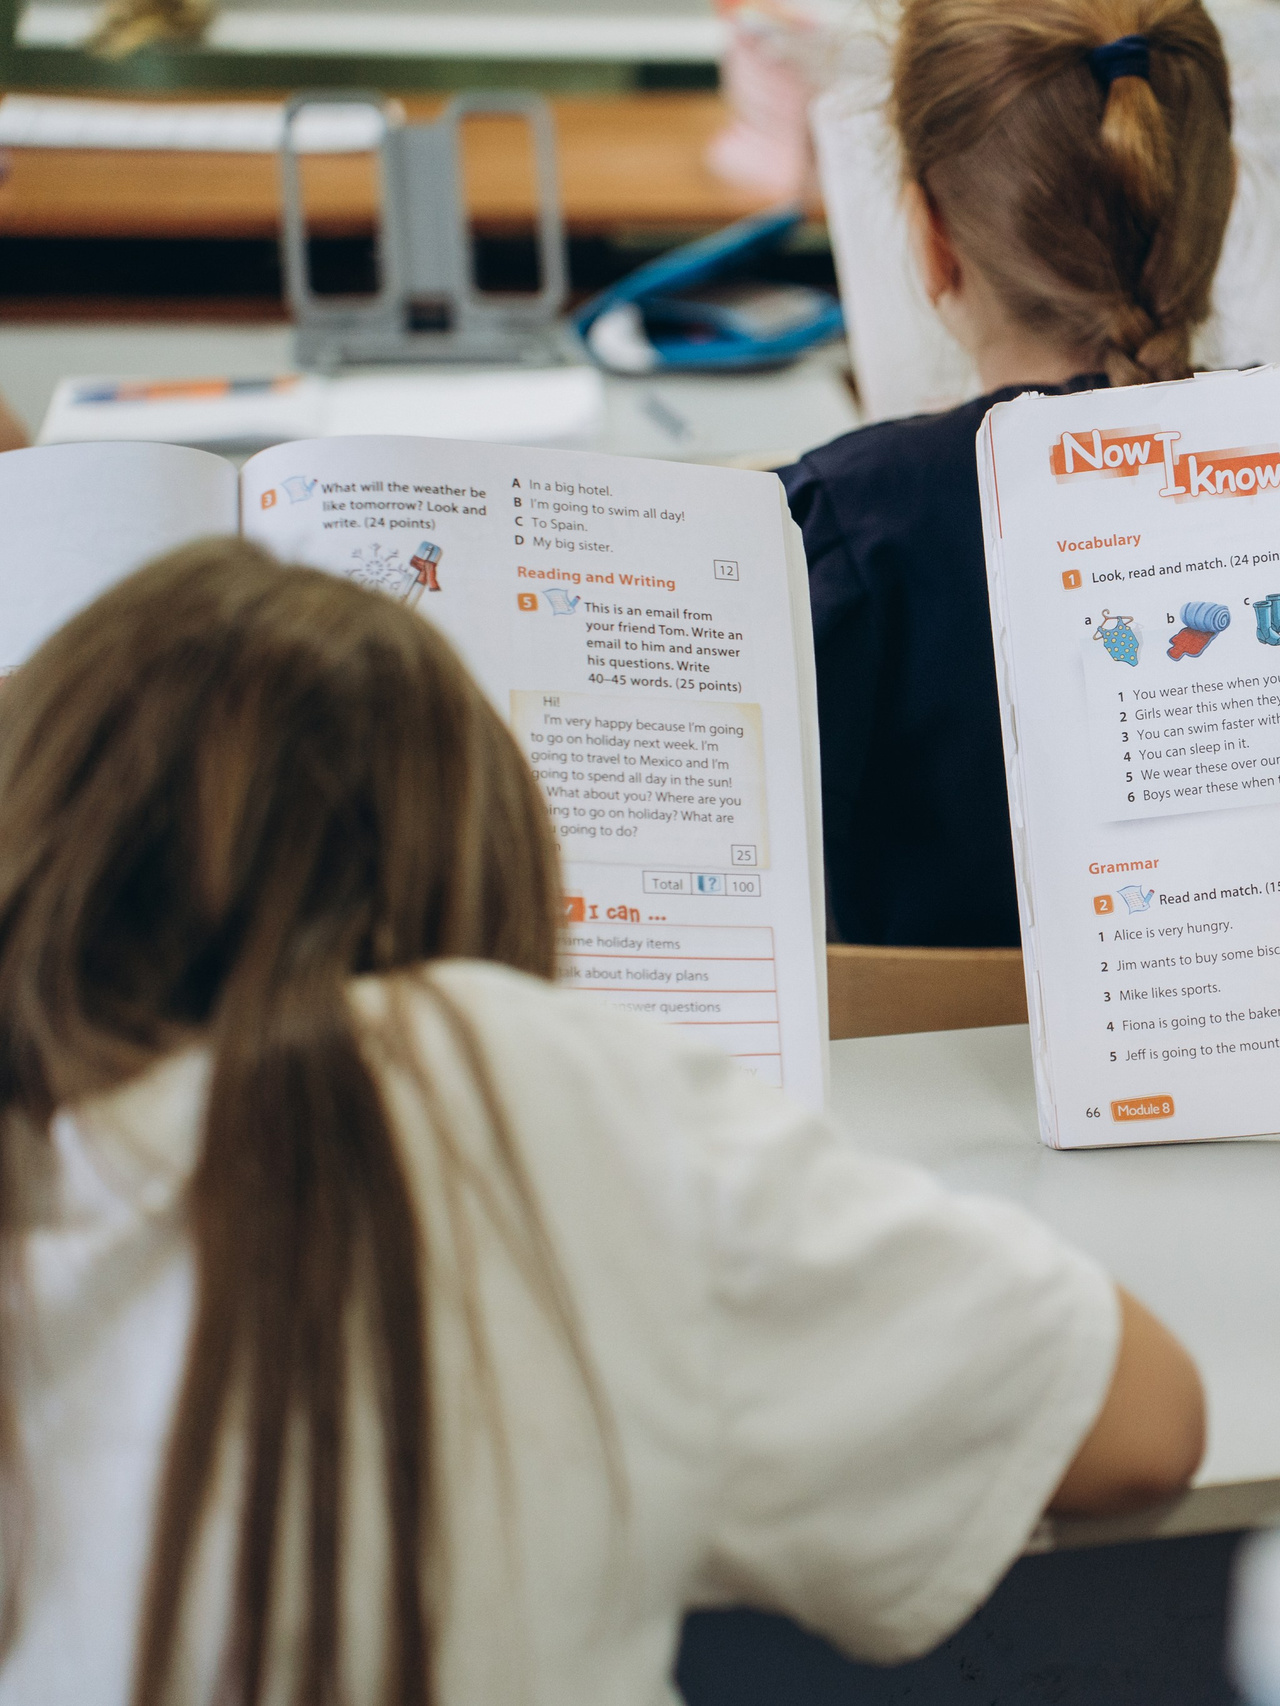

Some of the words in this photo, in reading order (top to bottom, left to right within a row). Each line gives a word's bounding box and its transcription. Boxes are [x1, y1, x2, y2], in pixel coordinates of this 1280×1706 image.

[1062, 429, 1150, 473] Now
[1153, 431, 1186, 497] I
[514, 515, 523, 526] C
[531, 517, 547, 528] To
[550, 518, 587, 532] Spain.
[514, 534, 524, 545] D
[533, 536, 551, 550] My
[555, 537, 574, 552] big
[578, 540, 613, 552] sister.
[1056, 533, 1141, 552] Vocabulary
[517, 566, 581, 584] Reading
[585, 572, 614, 584] and
[618, 573, 675, 592] Writing
[720, 565, 733, 576] 12
[1069, 574, 1075, 585] 1
[1091, 569, 1125, 583] Look,
[1128, 565, 1155, 578] read
[1158, 561, 1181, 575] and
[1185, 556, 1226, 571] match.
[1230, 554, 1248, 568] (24
[523, 596, 532, 608] 5
[583, 602, 610, 614] This
[613, 604, 623, 614] is
[626, 607, 642, 615] an
[645, 608, 679, 618] email
[682, 608, 712, 621] from
[1244, 597, 1250, 606] c
[1085, 617, 1092, 625] a
[1167, 613, 1175, 624] b
[585, 622, 614, 632] your
[618, 621, 655, 634] friend
[658, 624, 688, 636] Tom.
[691, 627, 724, 639] Write
[727, 631, 743, 640] an
[1117, 691, 1123, 702] 1
[1132, 689, 1156, 700] You
[1159, 686, 1188, 697] wear
[1191, 681, 1223, 693] these
[1226, 676, 1259, 689] when
[1119, 711, 1127, 722] 2
[1134, 707, 1161, 720] Girls
[1163, 705, 1193, 716] wear
[1196, 700, 1217, 713] this
[1220, 697, 1253, 710] when
[1121, 731, 1129, 742] 3
[1136, 729, 1160, 740] You
[1163, 727, 1184, 737] can
[1187, 721, 1218, 734] swim
[1221, 718, 1254, 730] faster
[1123, 751, 1131, 762] 4
[1138, 749, 1162, 760] You
[1165, 747, 1186, 757] can
[1189, 742, 1221, 754] sleep
[1223, 739, 1235, 750] in
[1238, 738, 1249, 749] it.
[1125, 771, 1133, 782] 5
[1140, 769, 1160, 780] We
[1162, 766, 1192, 777] wear
[1195, 762, 1227, 774] these
[1230, 759, 1257, 770] over
[1260, 756, 1280, 766] our
[1127, 791, 1135, 802] 6
[1143, 789, 1170, 802] Boys
[1173, 785, 1202, 796] wear
[1205, 781, 1238, 793] these
[1241, 776, 1274, 788] when
[737, 850, 751, 861] 25
[1088, 859, 1159, 874] Grammar
[652, 878, 683, 890] Total
[733, 881, 754, 893] 100
[1100, 899, 1108, 911] 2
[1159, 891, 1190, 905] Read
[1193, 888, 1216, 901] and
[1220, 883, 1262, 898] match.
[588, 904, 599, 919] I
[606, 904, 640, 923] can
[1098, 931, 1104, 942] 1
[1113, 928, 1142, 940] Alice
[1145, 927, 1155, 938] is
[1157, 926, 1183, 938] very
[1186, 921, 1232, 934] hungry.
[1103, 991, 1111, 1002] 3
[1119, 988, 1148, 1000] Mike
[1151, 986, 1178, 998] likes
[1181, 983, 1220, 998] sports.
[1086, 1107, 1101, 1118] 66
[1117, 1103, 1159, 1117] Module
[1162, 1102, 1170, 1113] 8
